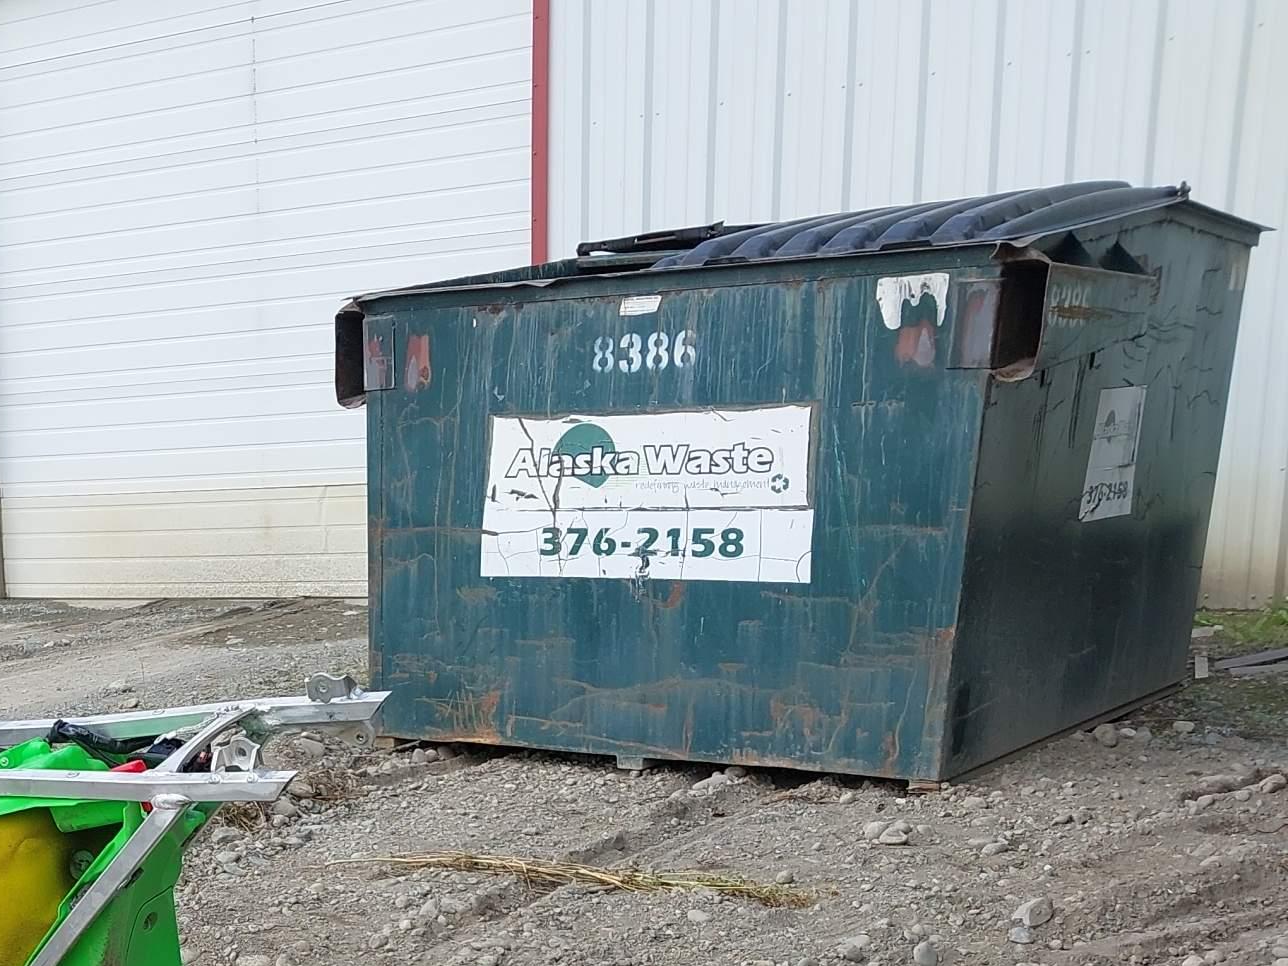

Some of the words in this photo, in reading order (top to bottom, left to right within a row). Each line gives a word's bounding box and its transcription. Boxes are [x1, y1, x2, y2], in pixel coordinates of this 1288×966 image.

[592, 329, 696, 374] 8386
[505, 445, 640, 478] Alaska
[643, 442, 774, 475] Waste
[539, 527, 745, 557] 376-2158
